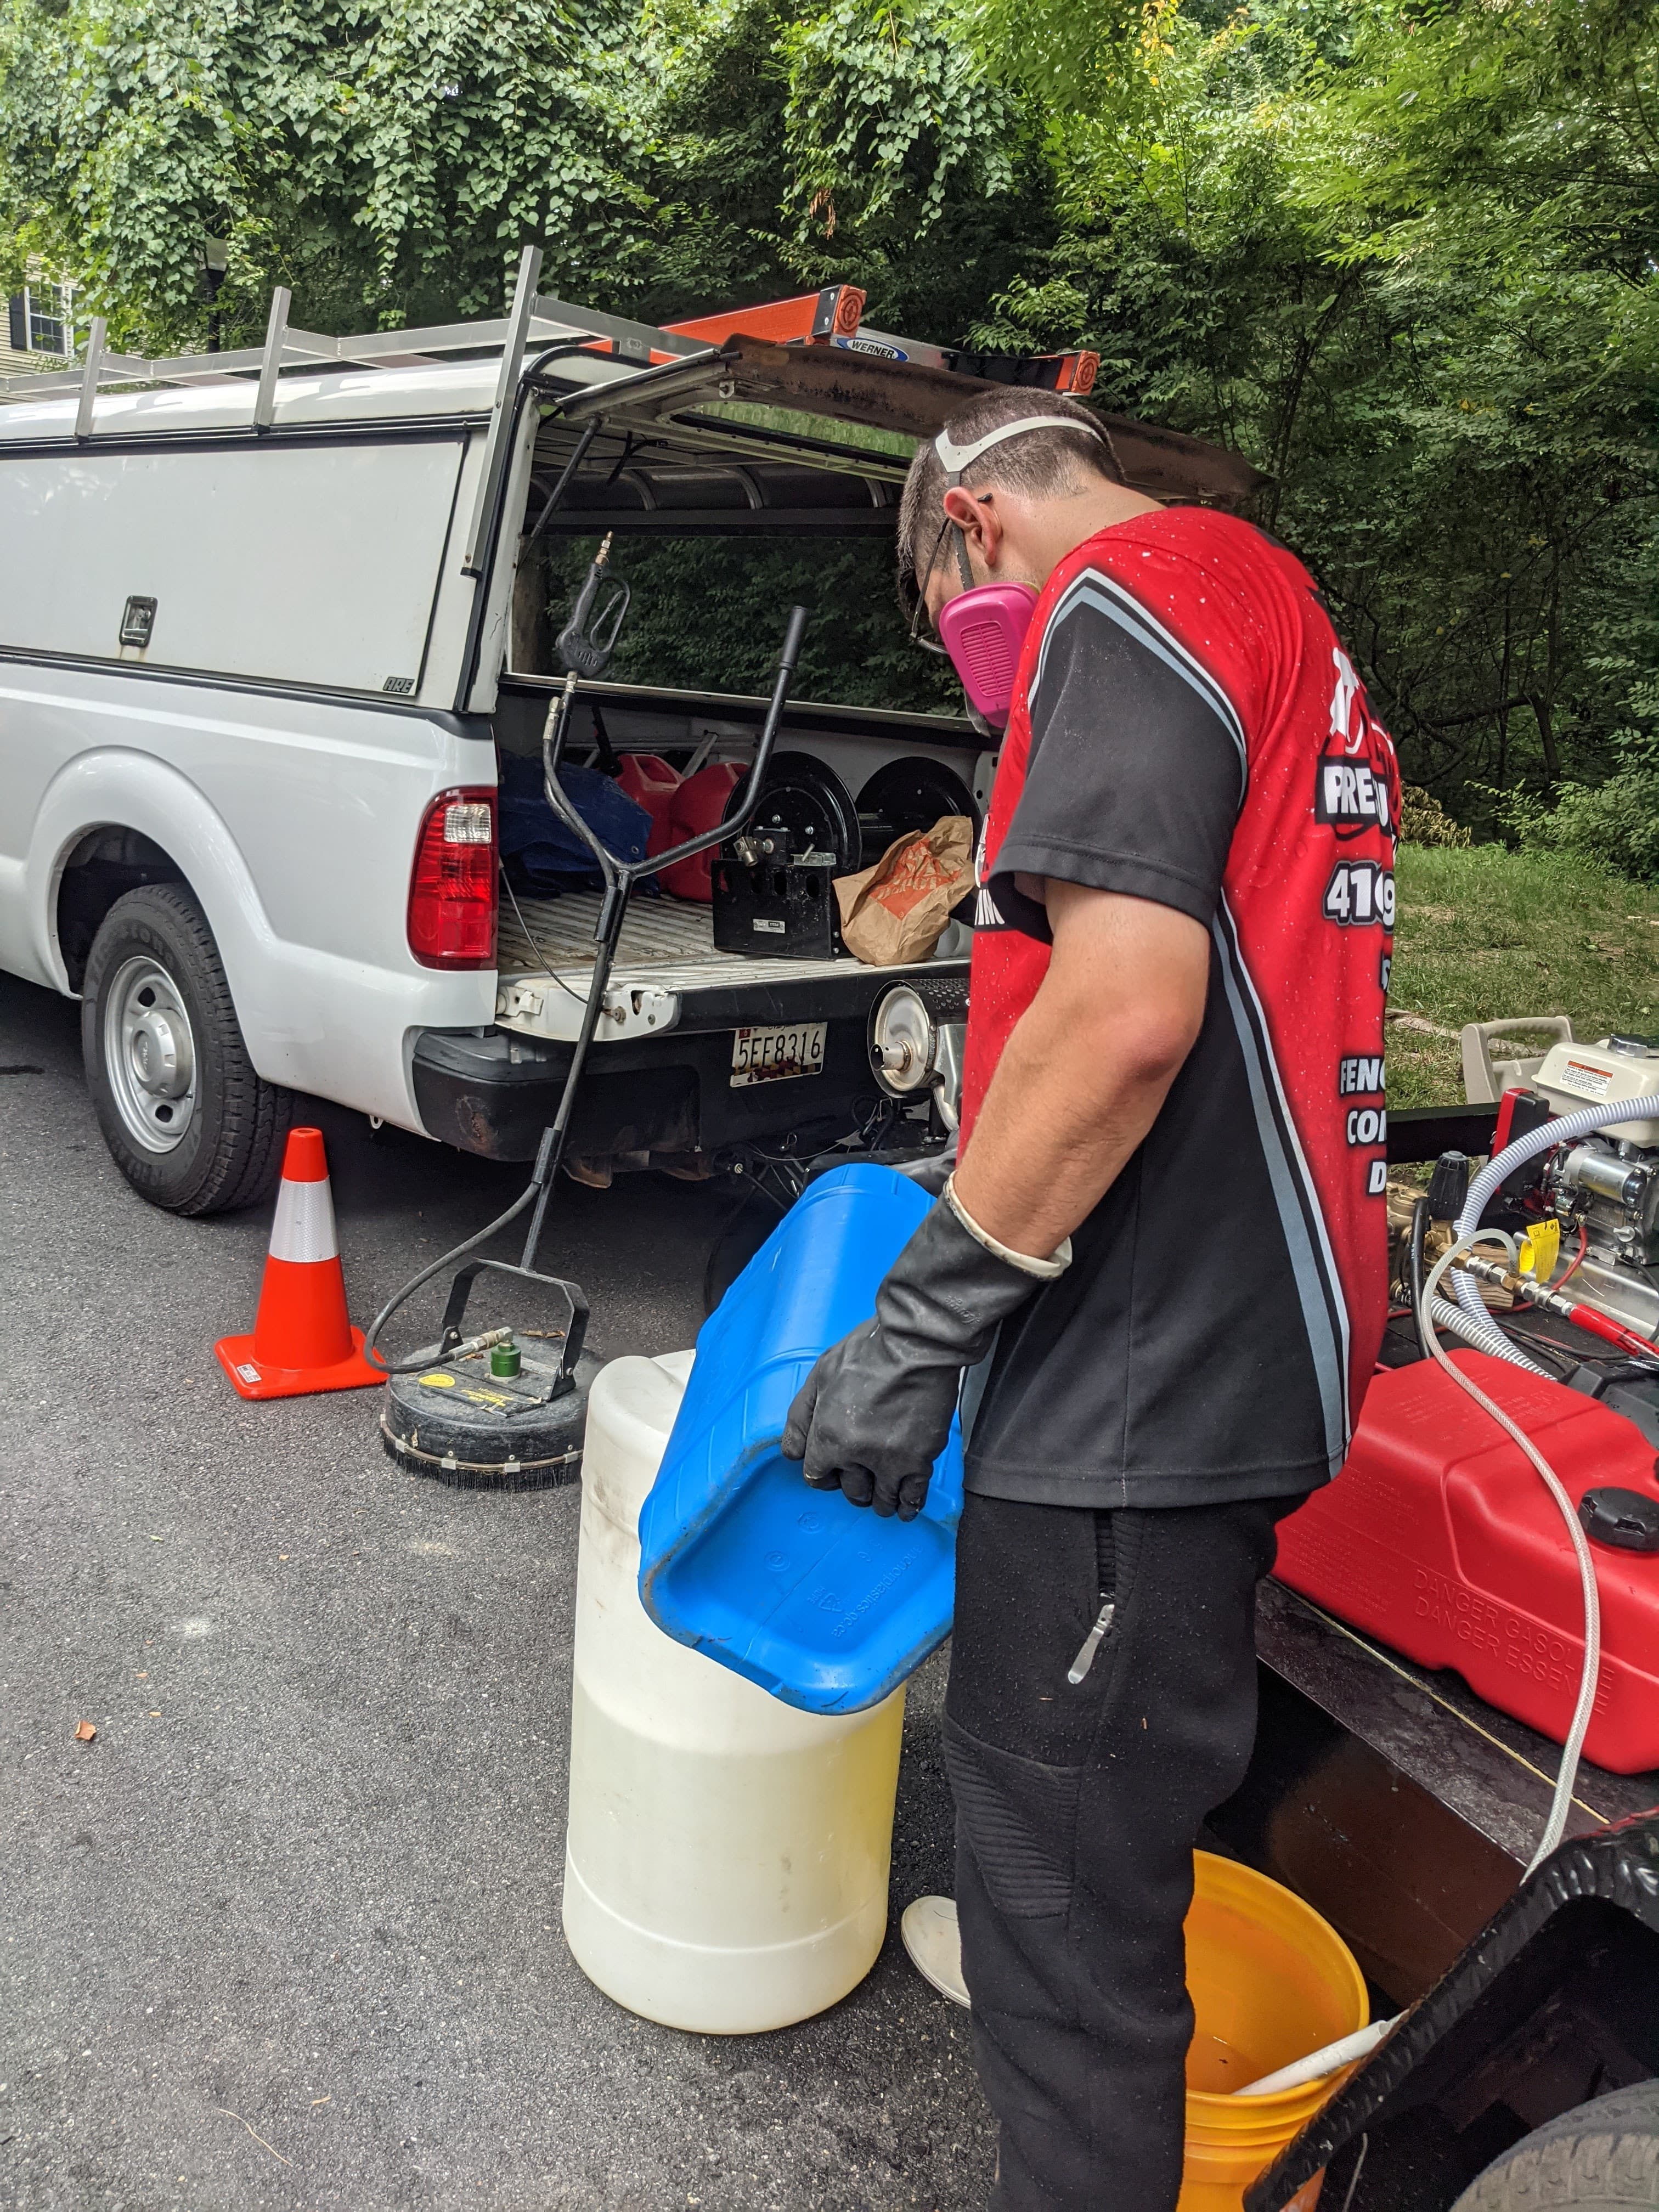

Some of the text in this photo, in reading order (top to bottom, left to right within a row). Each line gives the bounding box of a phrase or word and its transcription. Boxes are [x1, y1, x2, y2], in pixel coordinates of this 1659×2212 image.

[851, 340, 895, 359] WERNER
[383, 677, 415, 693] ARE
[1414, 1569, 1498, 1629] DANGER
[1415, 1596, 1609, 1715] DANGER ESSENE
